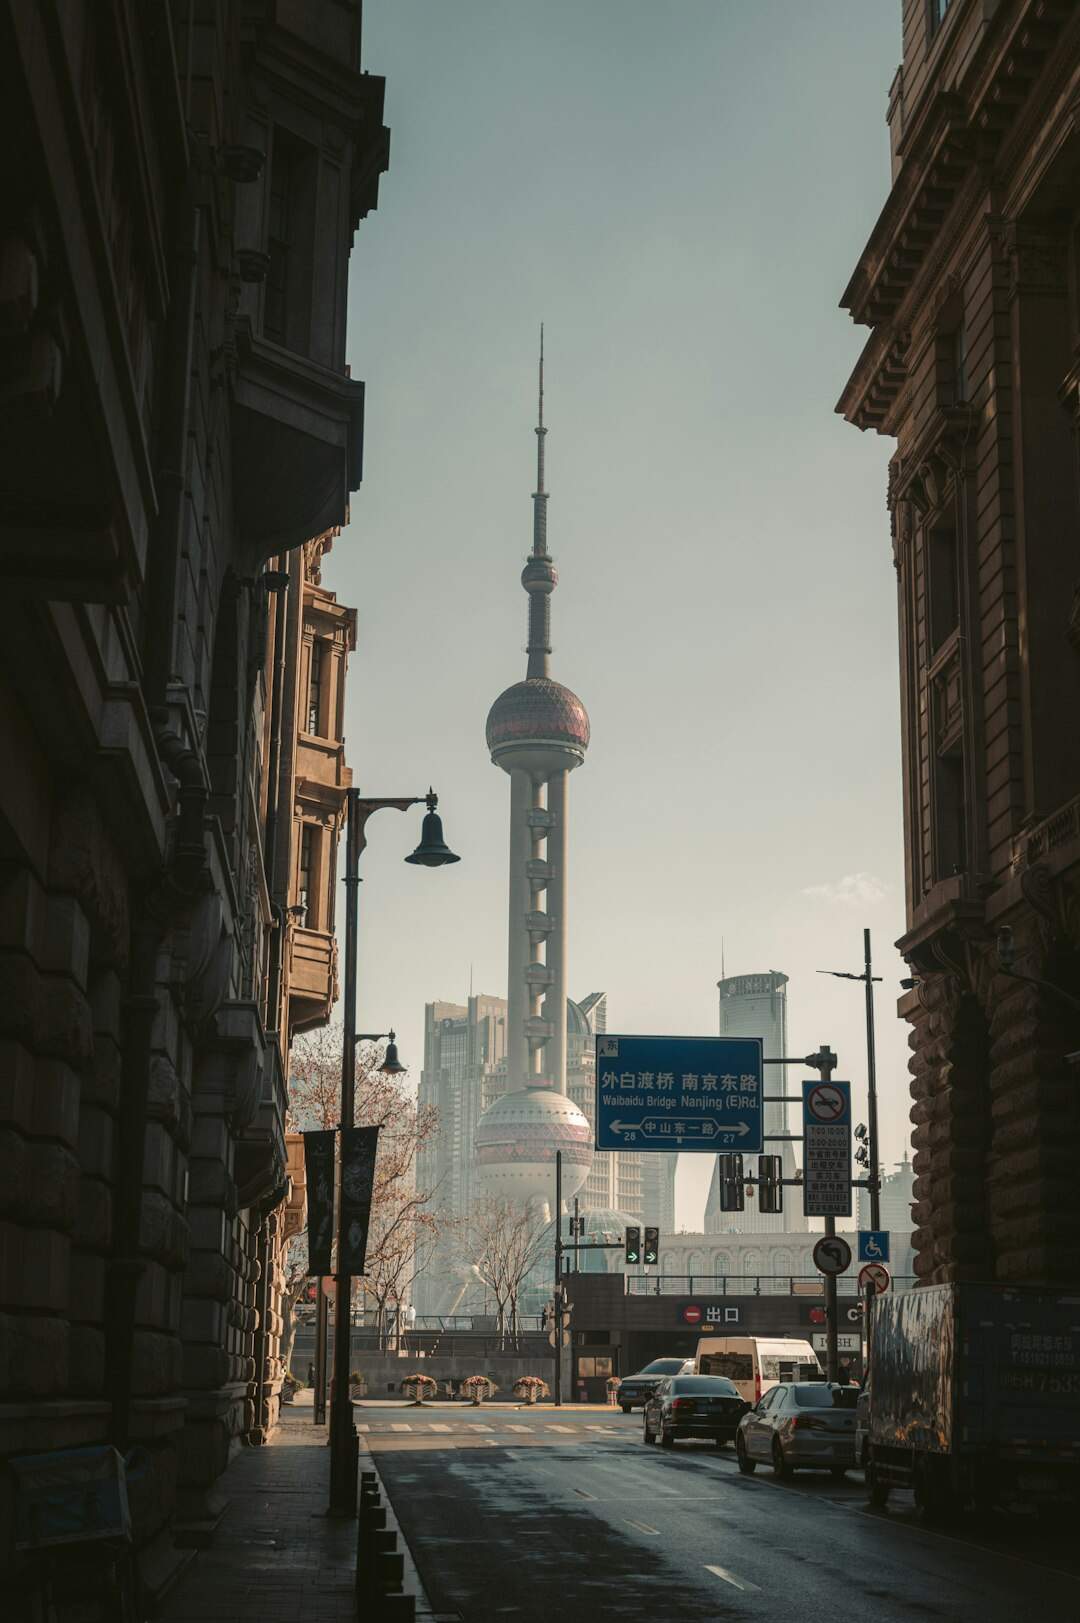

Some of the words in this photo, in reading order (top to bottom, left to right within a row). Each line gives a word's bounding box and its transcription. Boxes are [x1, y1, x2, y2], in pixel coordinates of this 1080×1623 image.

[601, 1071, 675, 1091] 外白渡桥
[681, 1072, 758, 1092] 南京东路
[602, 1094, 644, 1106] Waibaidu
[646, 1095, 677, 1109] Bridge
[681, 1095, 723, 1111] Nanjing
[644, 1121, 714, 1135] 中山东一路
[723, 1134, 735, 1144] 27
[706, 1306, 739, 1322] 出口
